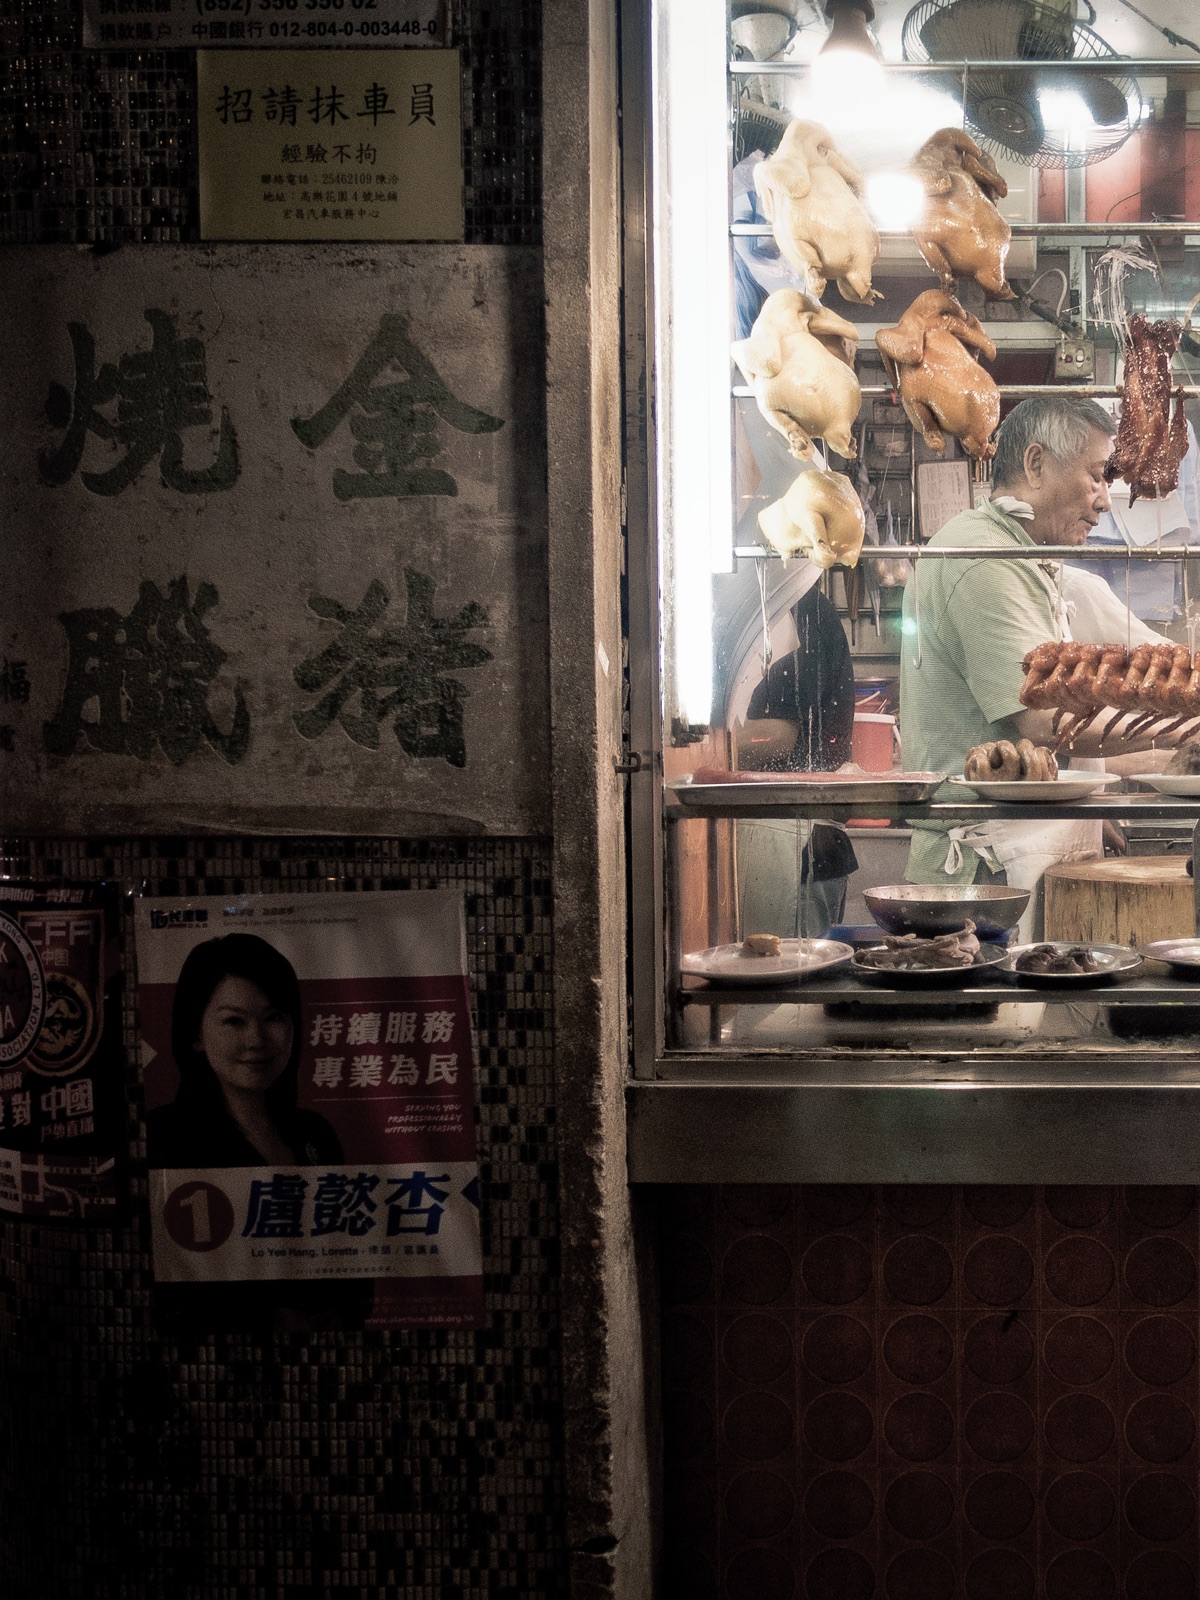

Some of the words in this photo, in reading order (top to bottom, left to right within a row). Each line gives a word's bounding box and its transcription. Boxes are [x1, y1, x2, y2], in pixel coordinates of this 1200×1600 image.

[269, 20, 437, 38] 012-804-0-003448-0
[215, 82, 437, 127] 招請抹車員
[280, 142, 377, 165] 經驗不拘
[309, 1010, 456, 1047] 持續服務
[311, 1053, 459, 1089] 專業為民
[442, 1103, 462, 1112] YOU
[384, 1125, 426, 1134] WITHOUT
